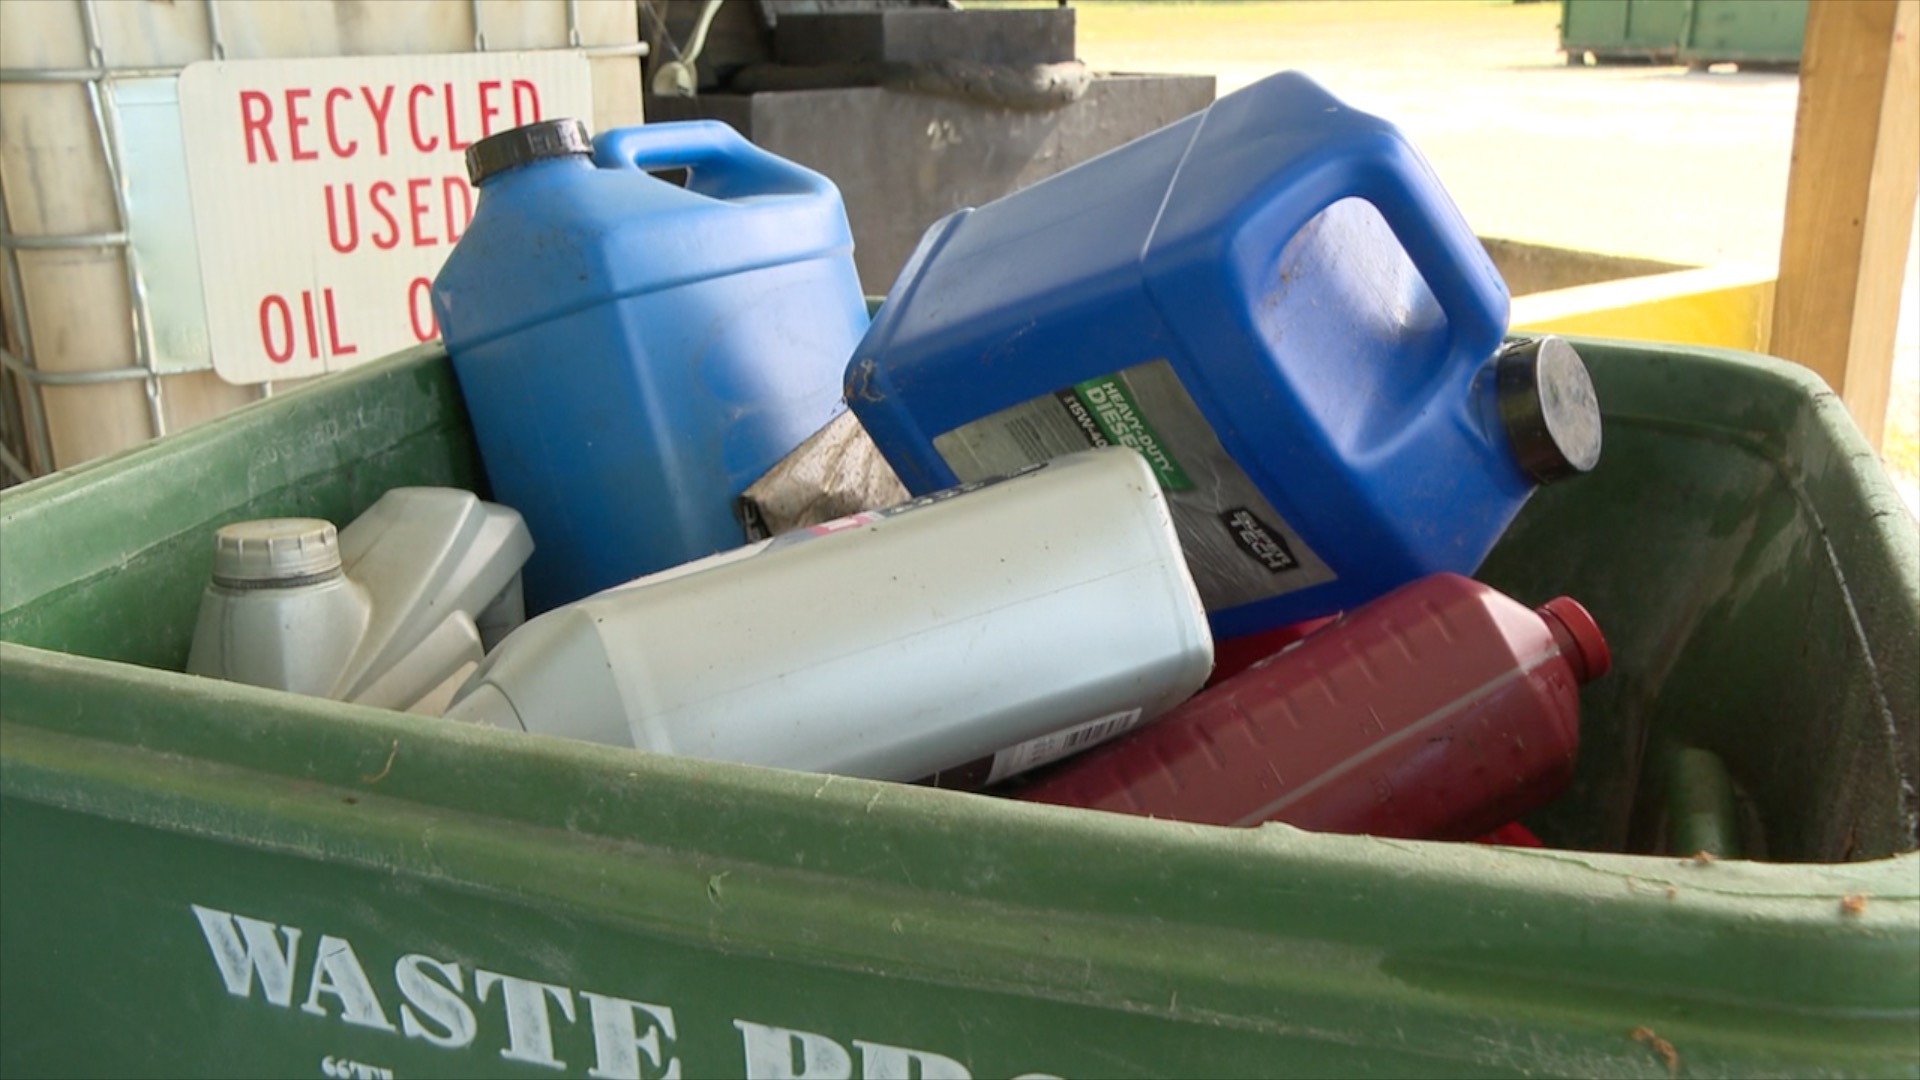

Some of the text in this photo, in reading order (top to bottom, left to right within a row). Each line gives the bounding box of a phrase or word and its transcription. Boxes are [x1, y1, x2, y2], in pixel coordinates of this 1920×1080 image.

[240, 79, 541, 163] RECYCLED
[324, 176, 473, 254] USED
[258, 288, 357, 364] OIL
[1087, 387, 1143, 453] DIESE
[1102, 383, 1174, 472] HEAVY-DUTY
[1230, 518, 1283, 568] TECH
[191, 904, 681, 1080] WASTE
